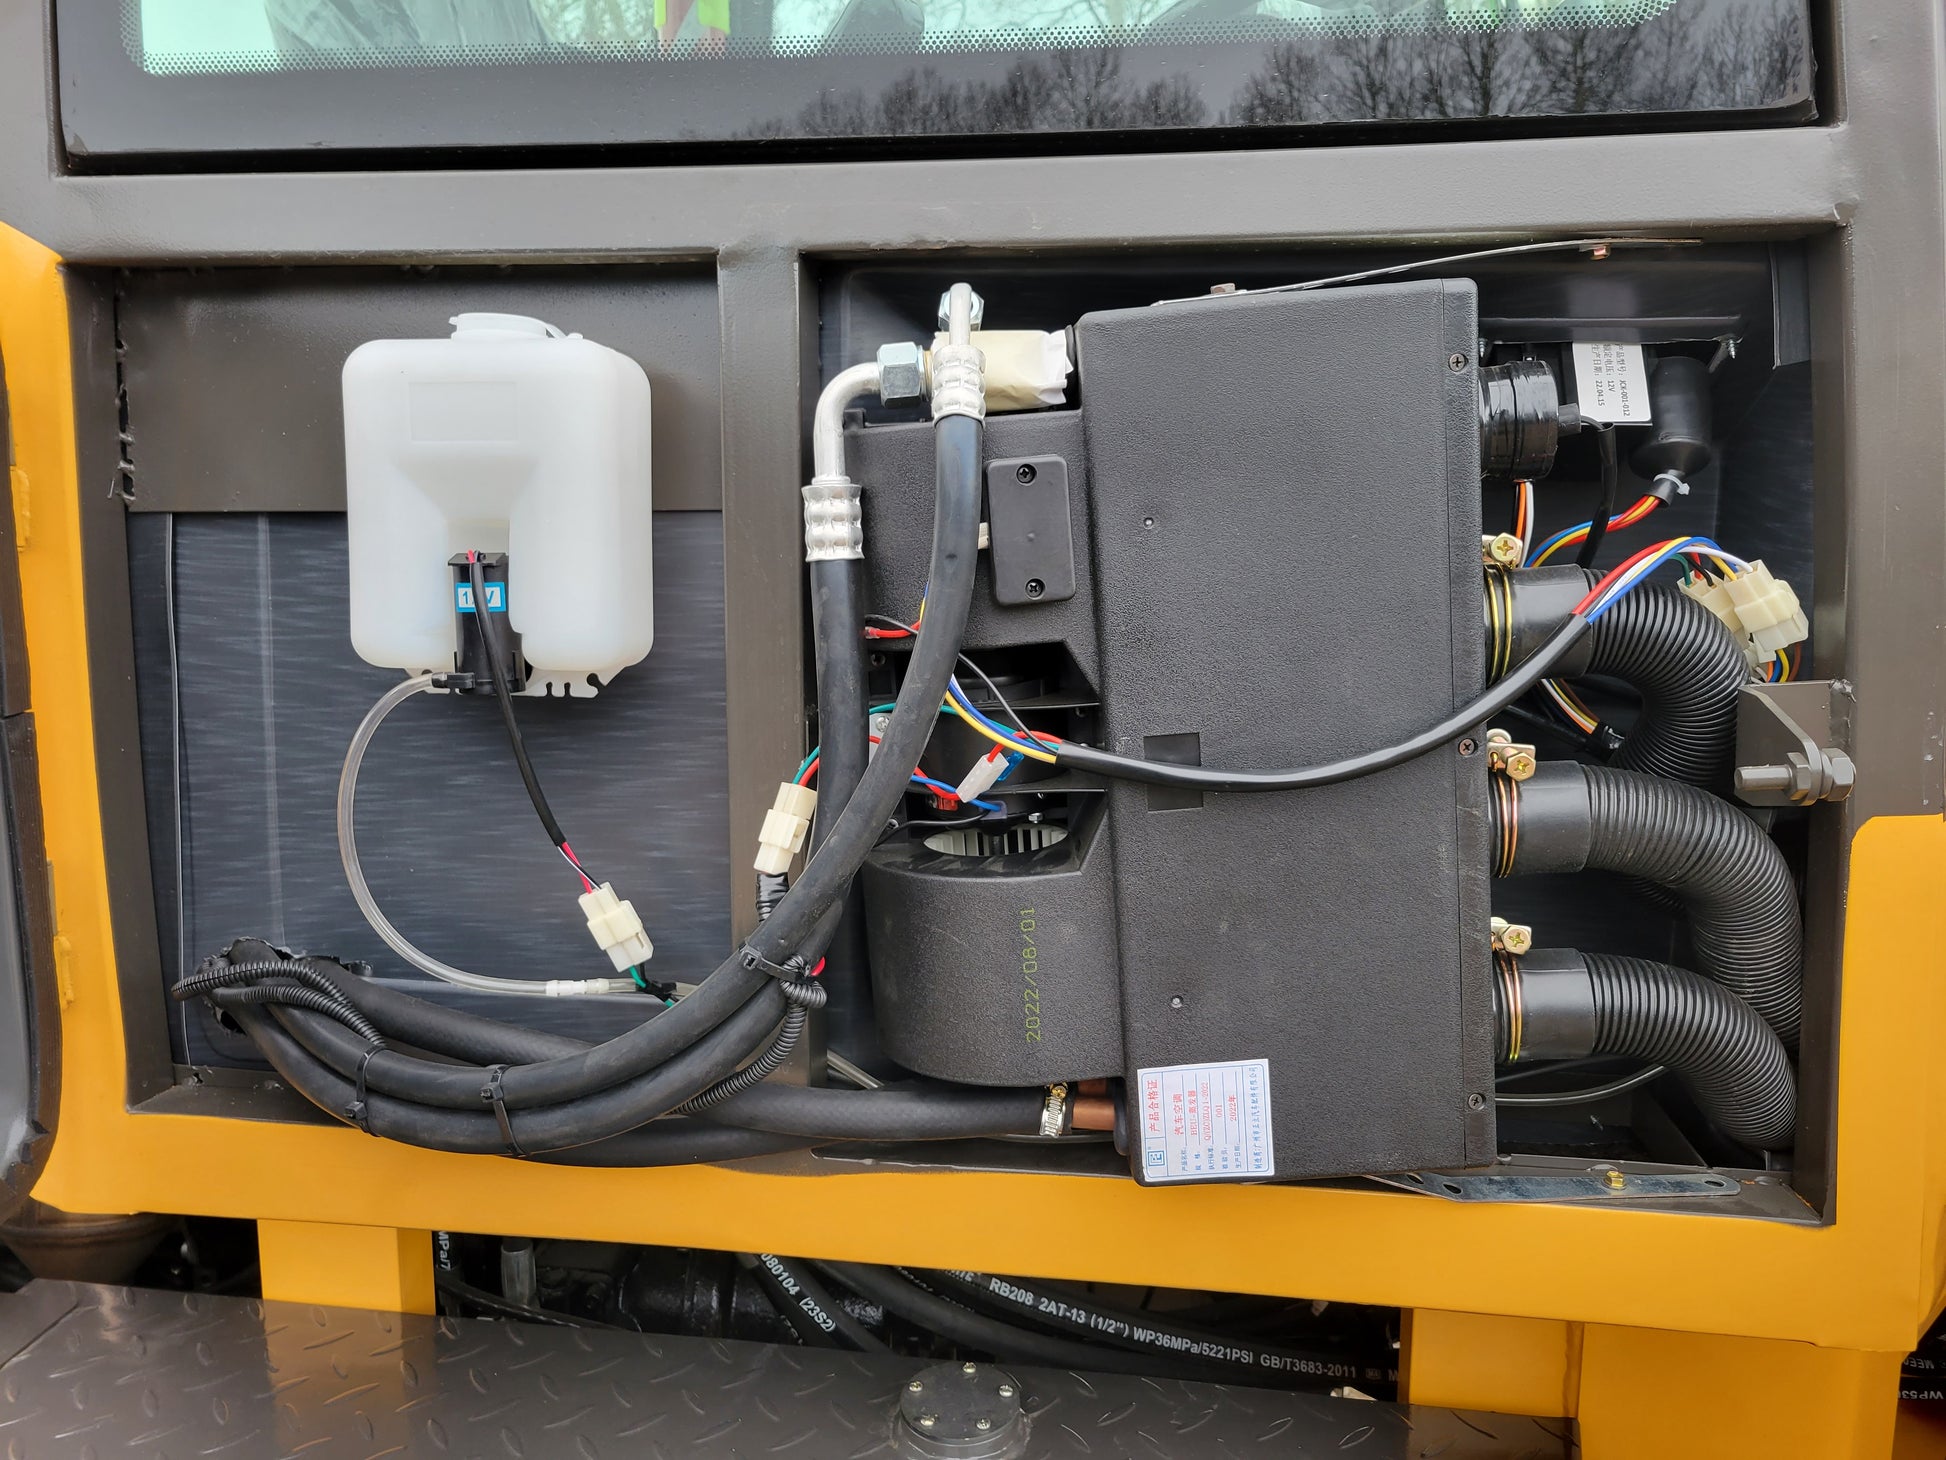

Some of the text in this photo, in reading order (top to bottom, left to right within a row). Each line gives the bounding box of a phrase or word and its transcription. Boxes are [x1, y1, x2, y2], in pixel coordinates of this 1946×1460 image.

[1595, 380, 1606, 407] 22.04.15
[1608, 380, 1616, 393] 12V
[1020, 908, 1041, 1043] 2022/08/01
[1147, 1079, 1160, 1132] 产品合格证
[1173, 1093, 1184, 1135] 汽车空调
[1228, 1095, 1237, 1121] 2022年
[799, 1296, 836, 1332] (23S2)
[989, 1277, 1034, 1306] RB208
[1038, 1297, 1087, 1324] 2AT-13
[1090, 1313, 1130, 1338] (1/2")
[1133, 1326, 1254, 1364] WP36MPa/5221PSI
[1260, 1353, 1357, 1379] GB/T3683-2011
